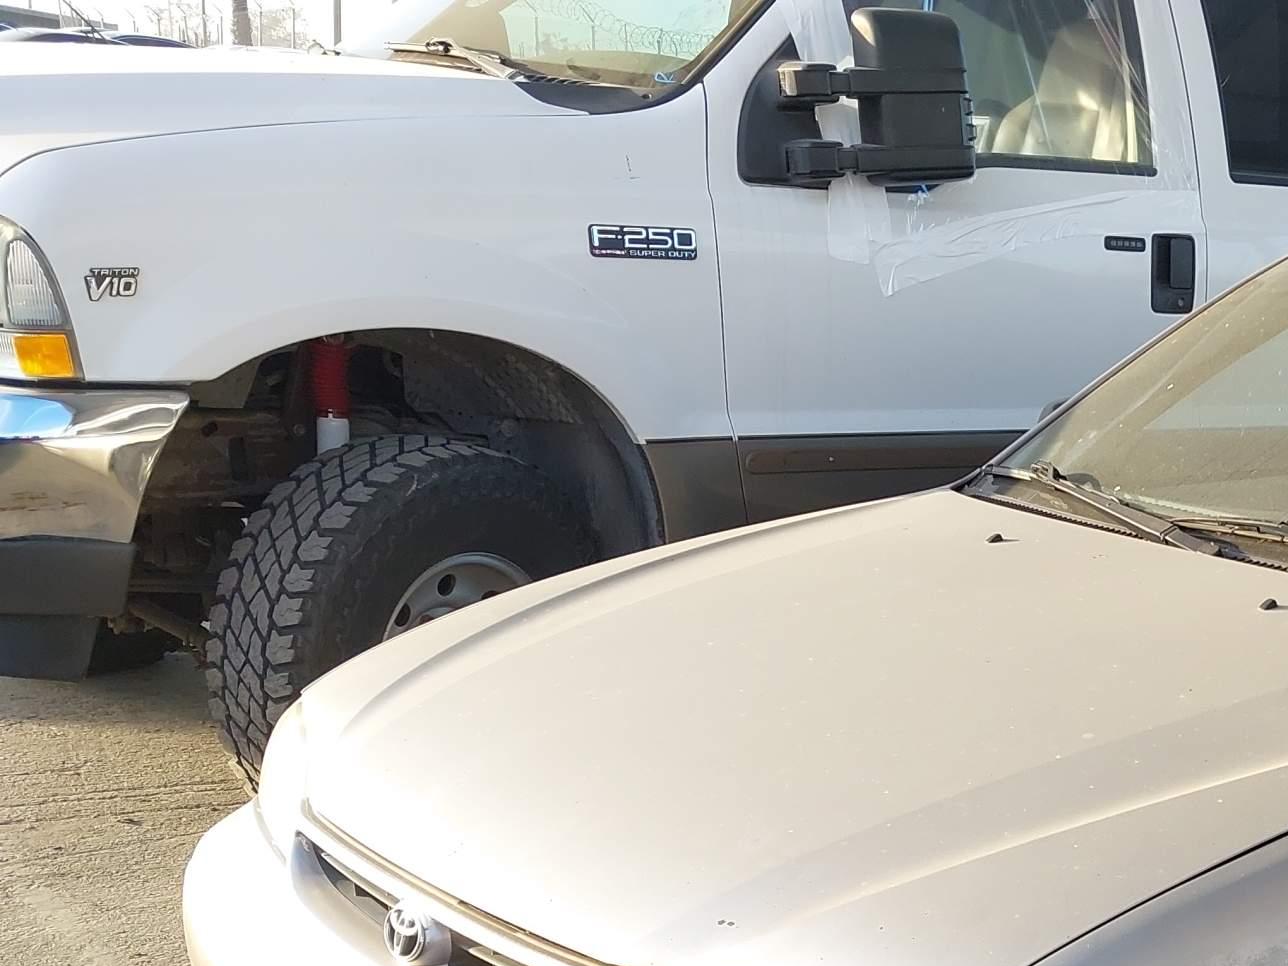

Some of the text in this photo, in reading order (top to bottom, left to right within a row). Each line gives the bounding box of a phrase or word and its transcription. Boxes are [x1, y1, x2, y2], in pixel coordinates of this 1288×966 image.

[629, 249, 666, 257] SUPER
[91, 268, 139, 276] TRITON
[84, 276, 138, 301] V10
